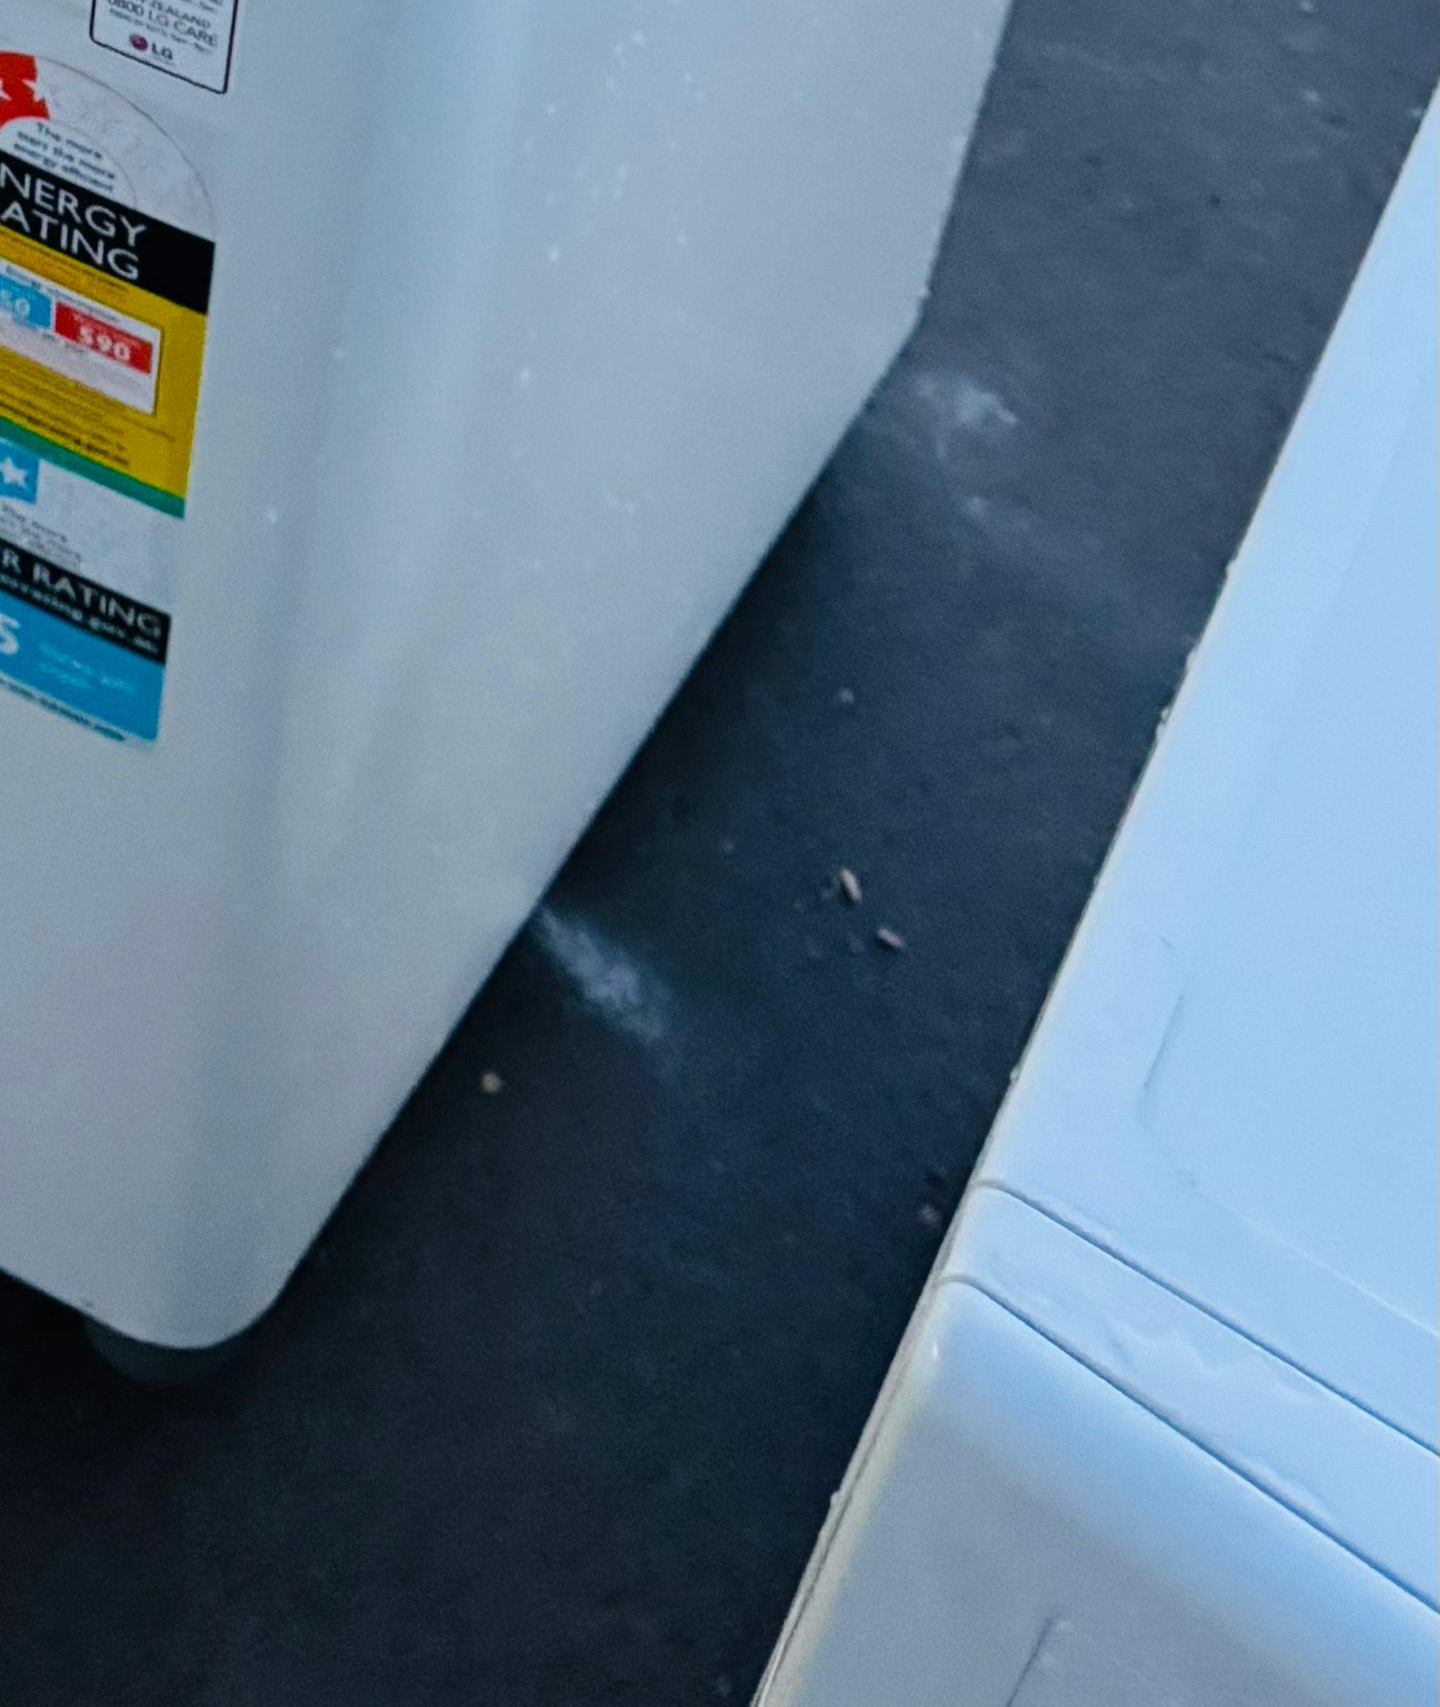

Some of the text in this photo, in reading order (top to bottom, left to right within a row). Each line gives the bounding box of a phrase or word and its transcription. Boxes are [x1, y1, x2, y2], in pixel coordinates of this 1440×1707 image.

[148, 10, 169, 28] LG
[173, 19, 218, 48] CARE
[151, 42, 174, 61] LG
[33, 562, 161, 639] RATING
